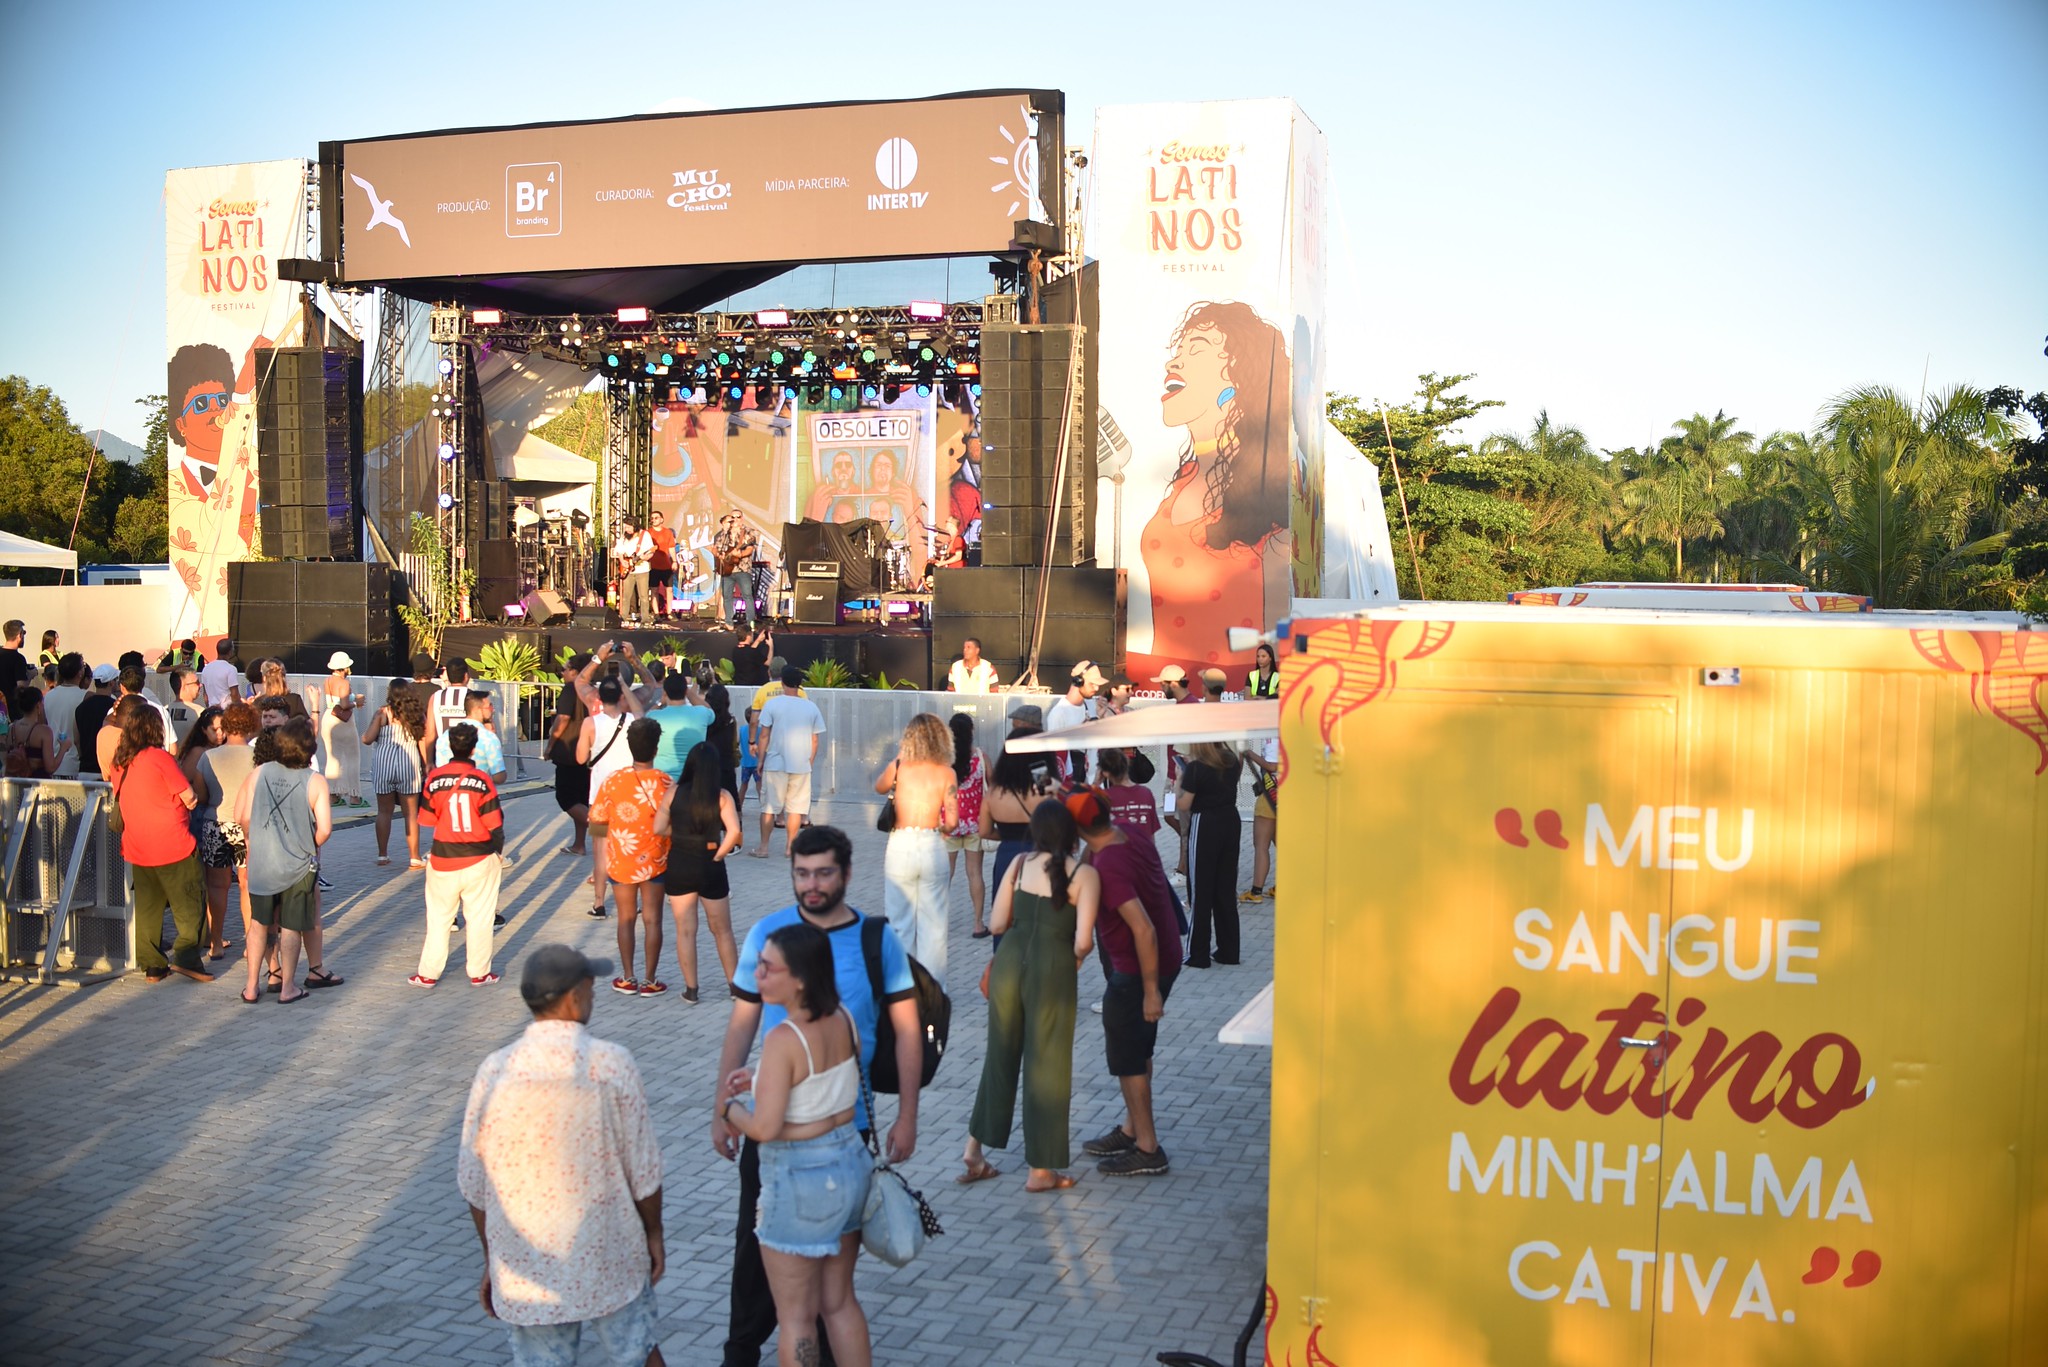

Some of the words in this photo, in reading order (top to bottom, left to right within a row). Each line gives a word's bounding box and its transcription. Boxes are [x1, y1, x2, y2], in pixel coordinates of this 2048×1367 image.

[547, 171, 555, 183] 4
[672, 169, 719, 187] MU
[765, 178, 796, 192] MÍDIA
[798, 177, 850, 190] PARCEIRA:
[1149, 165, 1238, 202] LATI
[516, 181, 549, 212] Br
[595, 188, 655, 202] CURADORIA:
[666, 182, 732, 208] CHO!
[867, 193, 908, 211] INTER
[910, 191, 929, 208] TV
[437, 199, 491, 214] PRODUÇÃO:
[684, 202, 728, 212] festival
[516, 217, 549, 226] branding
[1149, 208, 1244, 251] NOS
[200, 218, 264, 252] LATI
[201, 255, 269, 293] NOS
[1162, 263, 1226, 273] FESTIVAL
[211, 302, 256, 312] FESTIVAL
[819, 419, 909, 439] OBSOLETO
[448, 792, 472, 833] 11
[1512, 907, 1821, 984] SANGUE
[1449, 986, 1876, 1130] latino
